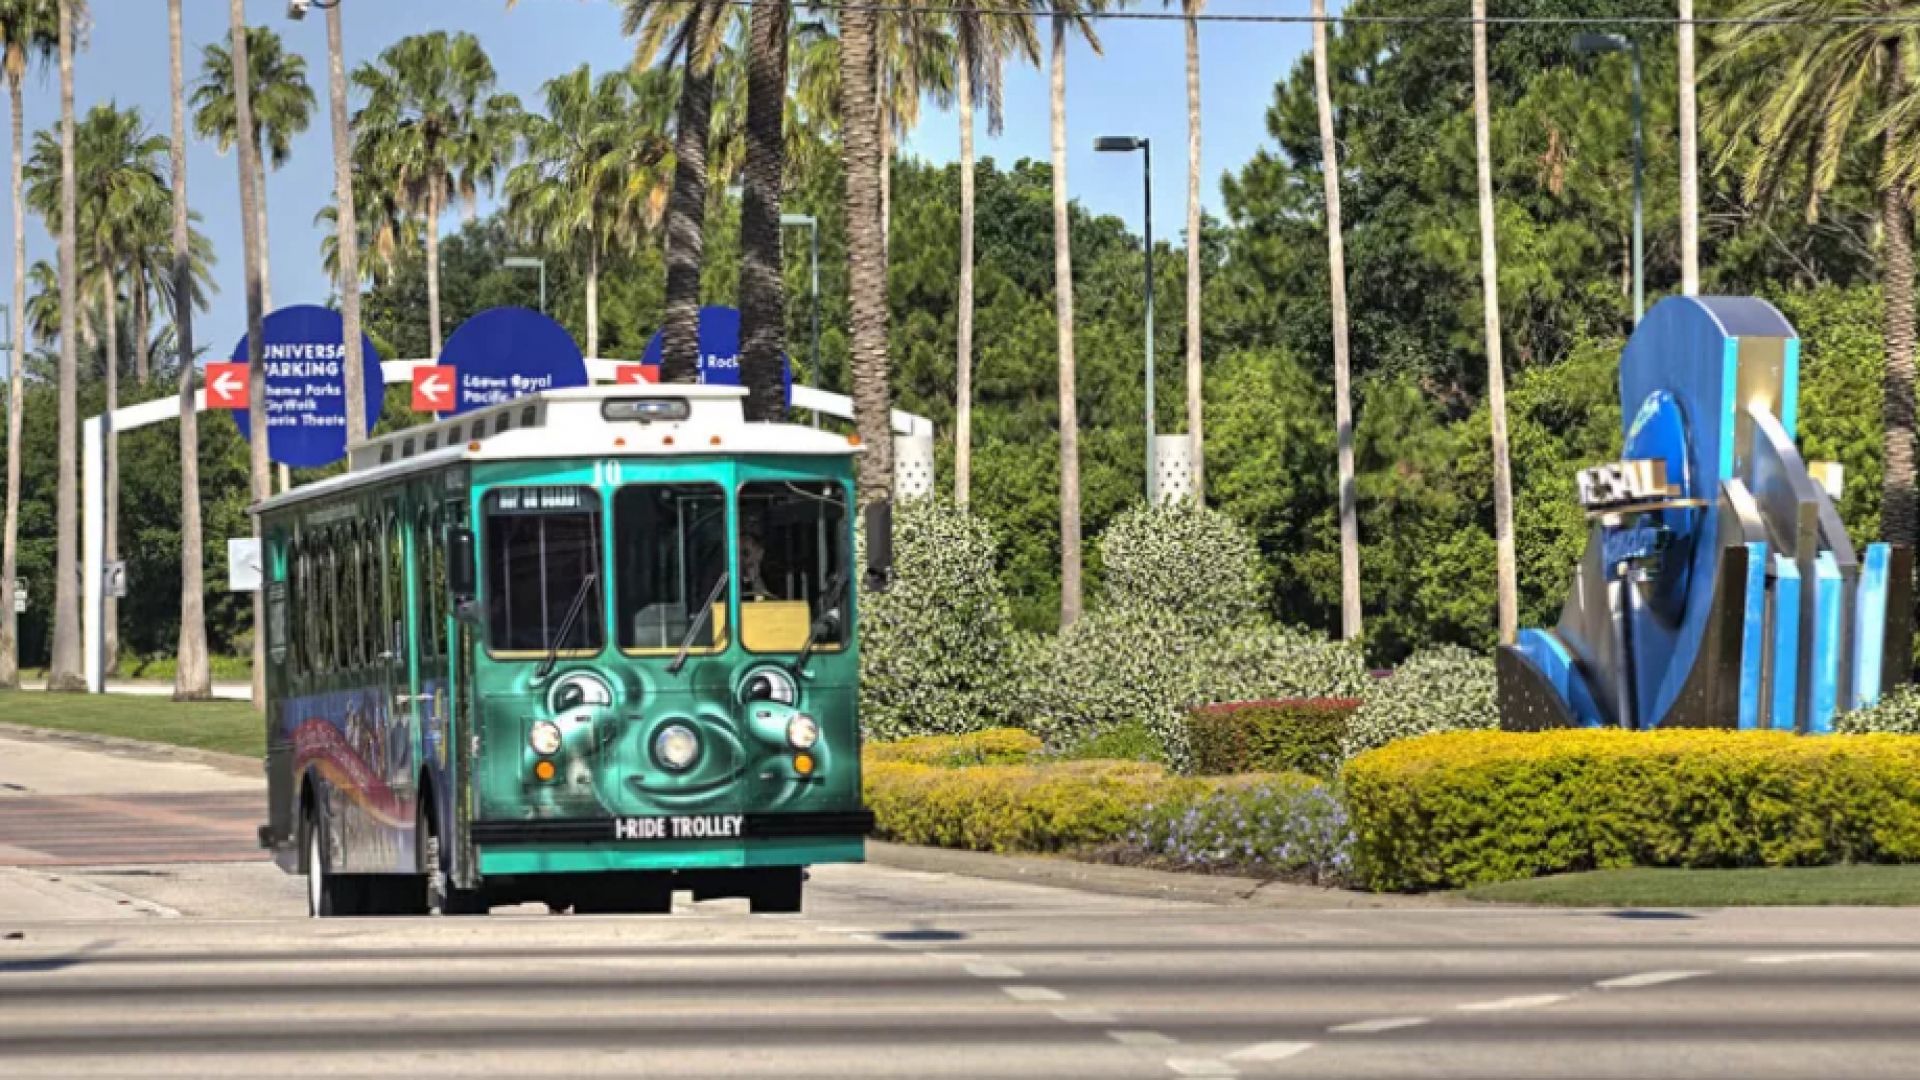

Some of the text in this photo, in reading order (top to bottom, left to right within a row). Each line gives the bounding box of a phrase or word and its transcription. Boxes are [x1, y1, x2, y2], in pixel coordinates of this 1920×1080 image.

[263, 344, 346, 360] UNIVERSA
[265, 382, 341, 396] heme Parks
[301, 412, 346, 426] Theate
[591, 459, 622, 488] 10
[615, 814, 744, 840] I-RIDE TROLLEY
